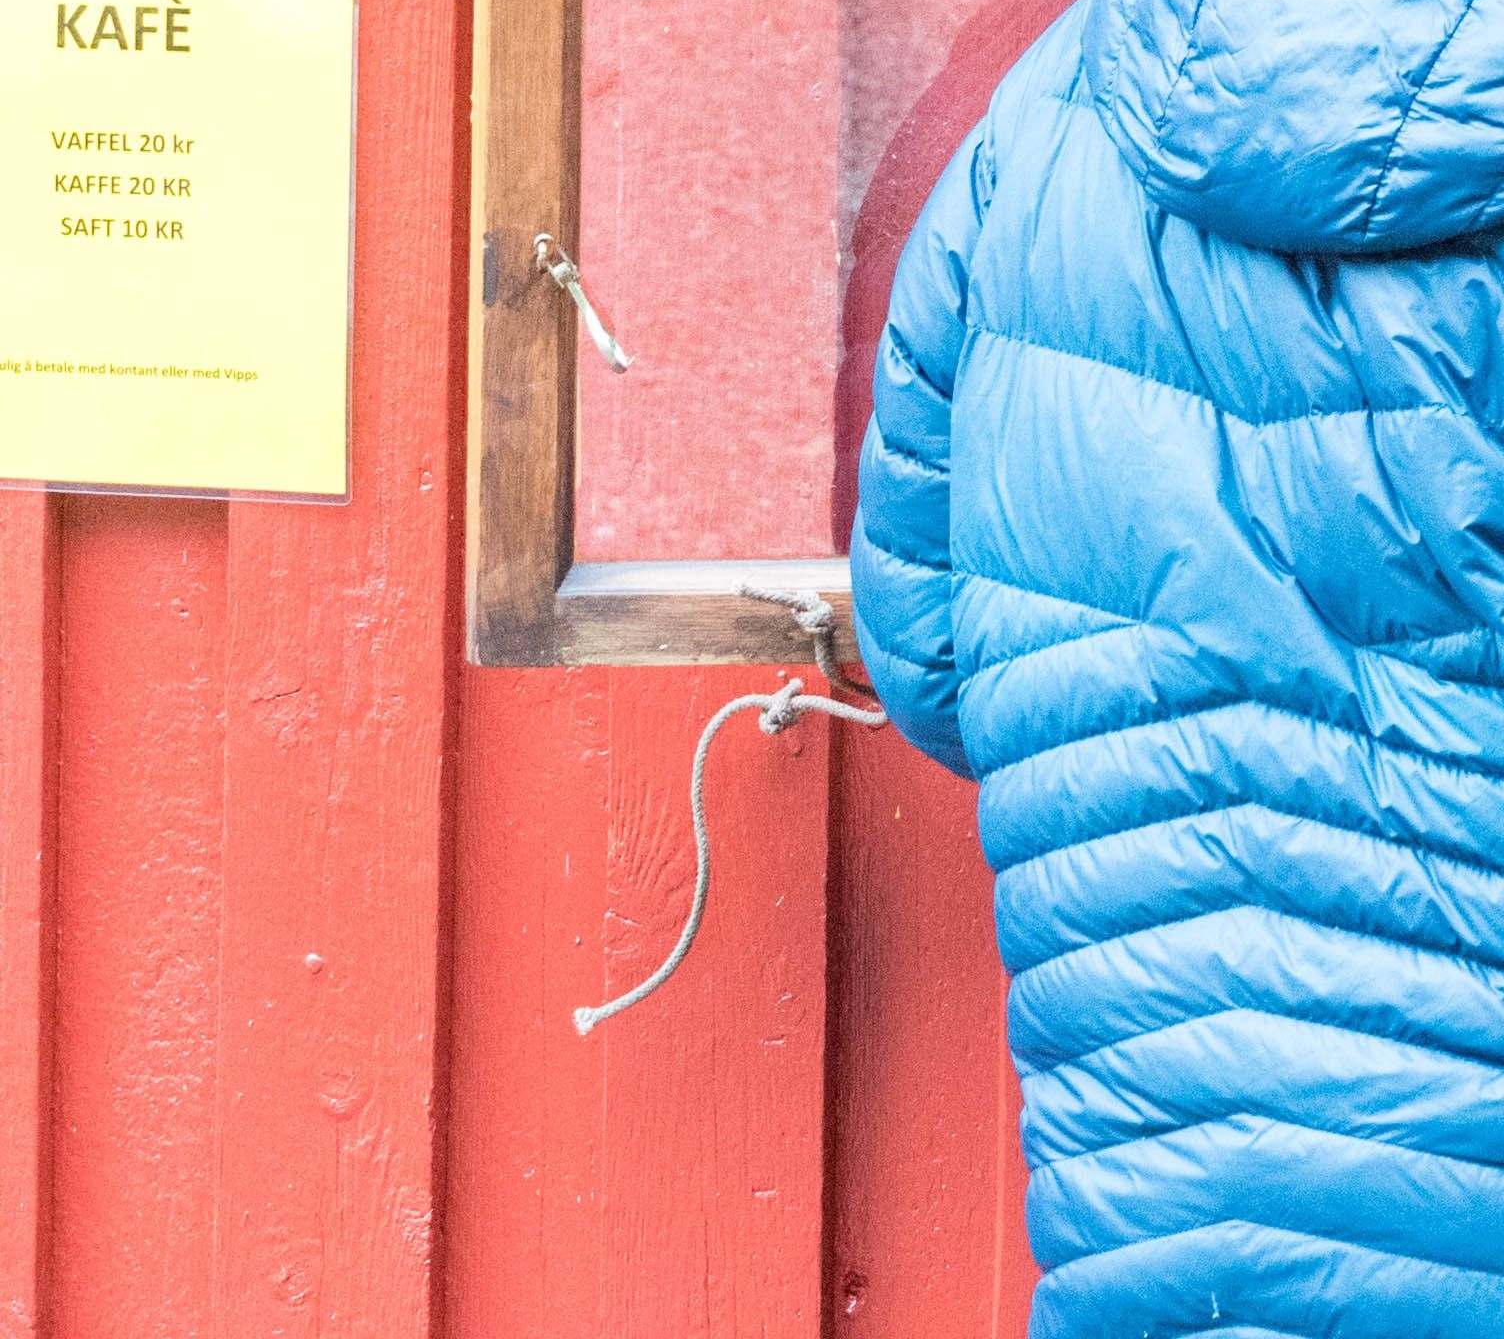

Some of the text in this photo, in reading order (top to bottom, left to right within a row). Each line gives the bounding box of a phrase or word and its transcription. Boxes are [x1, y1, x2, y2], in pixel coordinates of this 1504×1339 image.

[50, 130, 195, 155] VAFFEL 20 kr
[54, 173, 192, 198] KAFFE 20 KR
[60, 216, 184, 240] SAFT 10 KR
[0, 359, 259, 383] ulig å betale med kontant eller med Vipps
